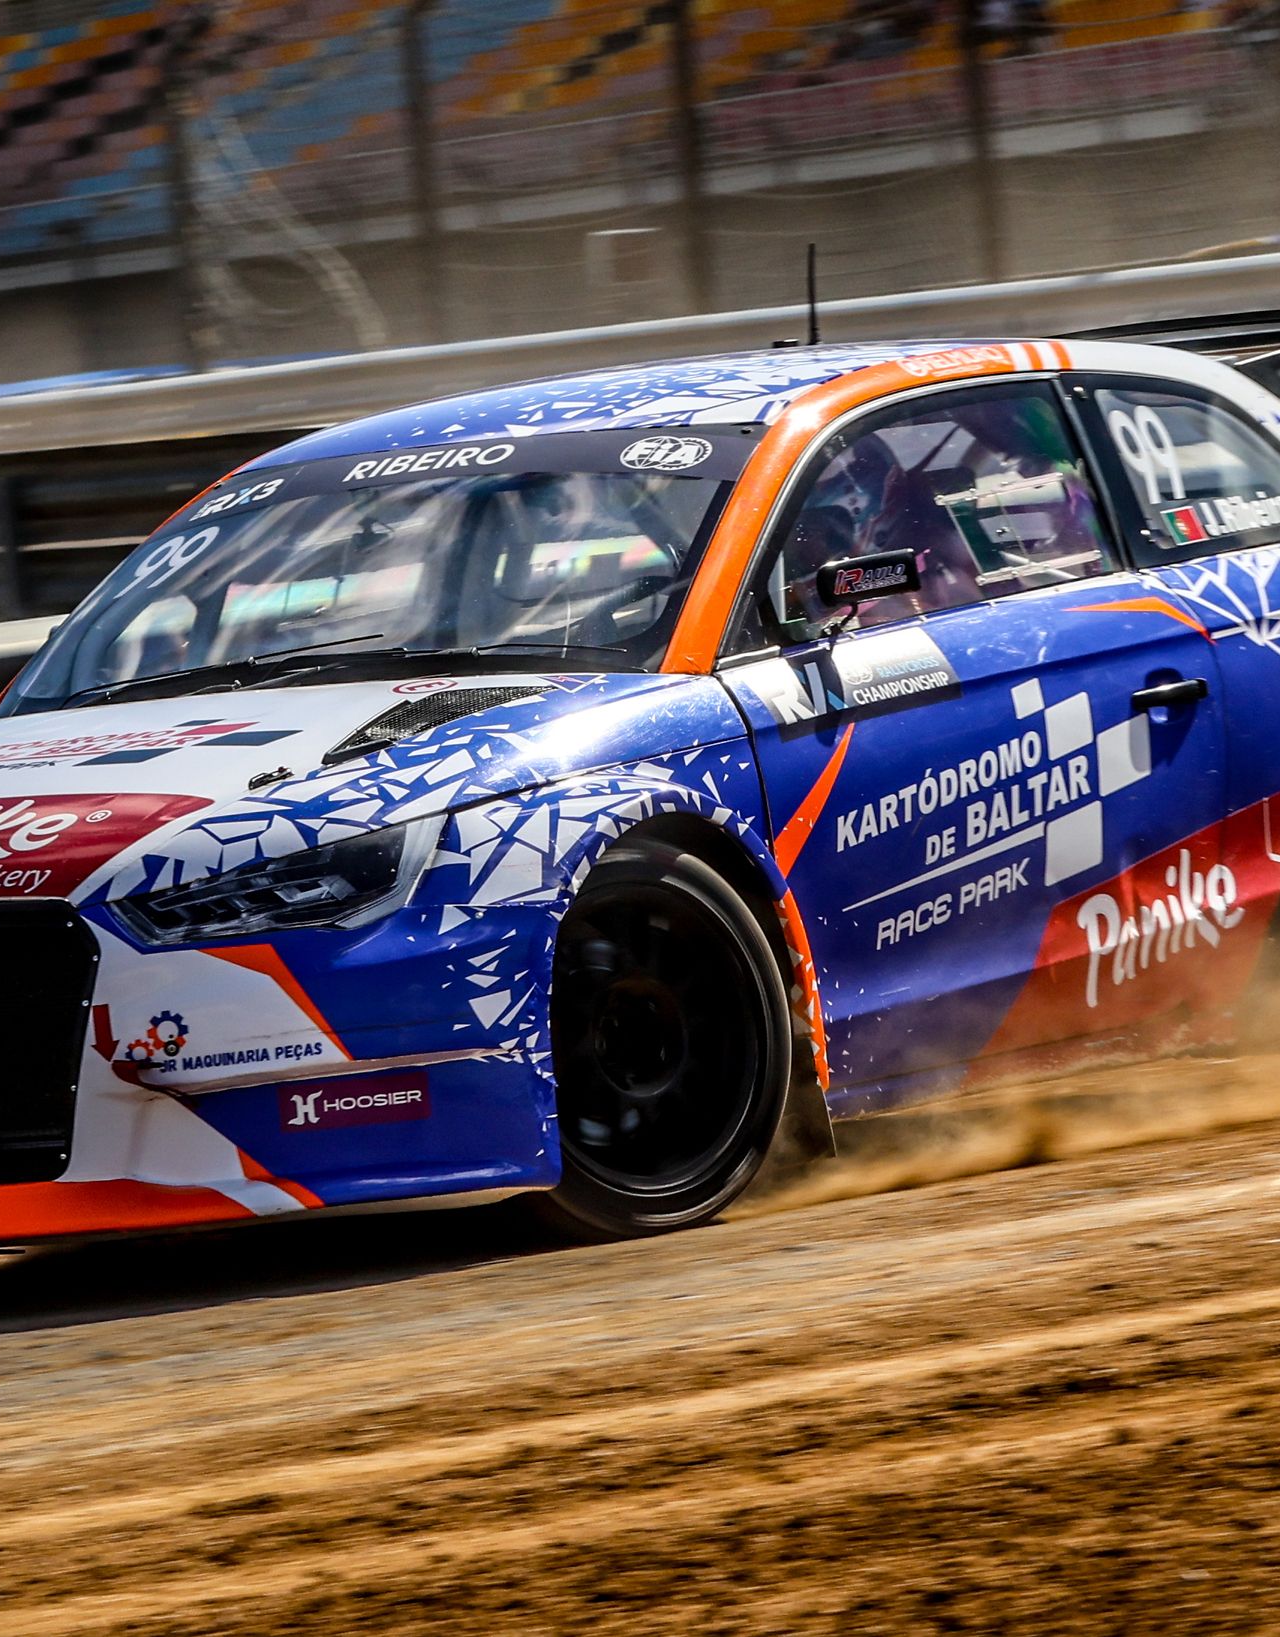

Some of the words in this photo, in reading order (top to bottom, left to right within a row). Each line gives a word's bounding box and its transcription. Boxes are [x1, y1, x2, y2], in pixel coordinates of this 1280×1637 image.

[341, 443, 515, 483] RIBEIRO
[1108, 405, 1186, 505] 99
[113, 526, 220, 599] 99
[852, 671, 950, 706] CHAMPIONSHIP
[836, 730, 1042, 853] KARTÓDROMO
[925, 826, 956, 866] DE
[966, 755, 1091, 848] BALTAR
[876, 893, 952, 950] RACE
[959, 857, 1030, 914] PARK
[1076, 848, 1246, 1008] Panike
[183, 1047, 270, 1072] MAQUINARIA
[275, 1042, 323, 1062] PEÇAS
[323, 1089, 423, 1113] HOOSIER
